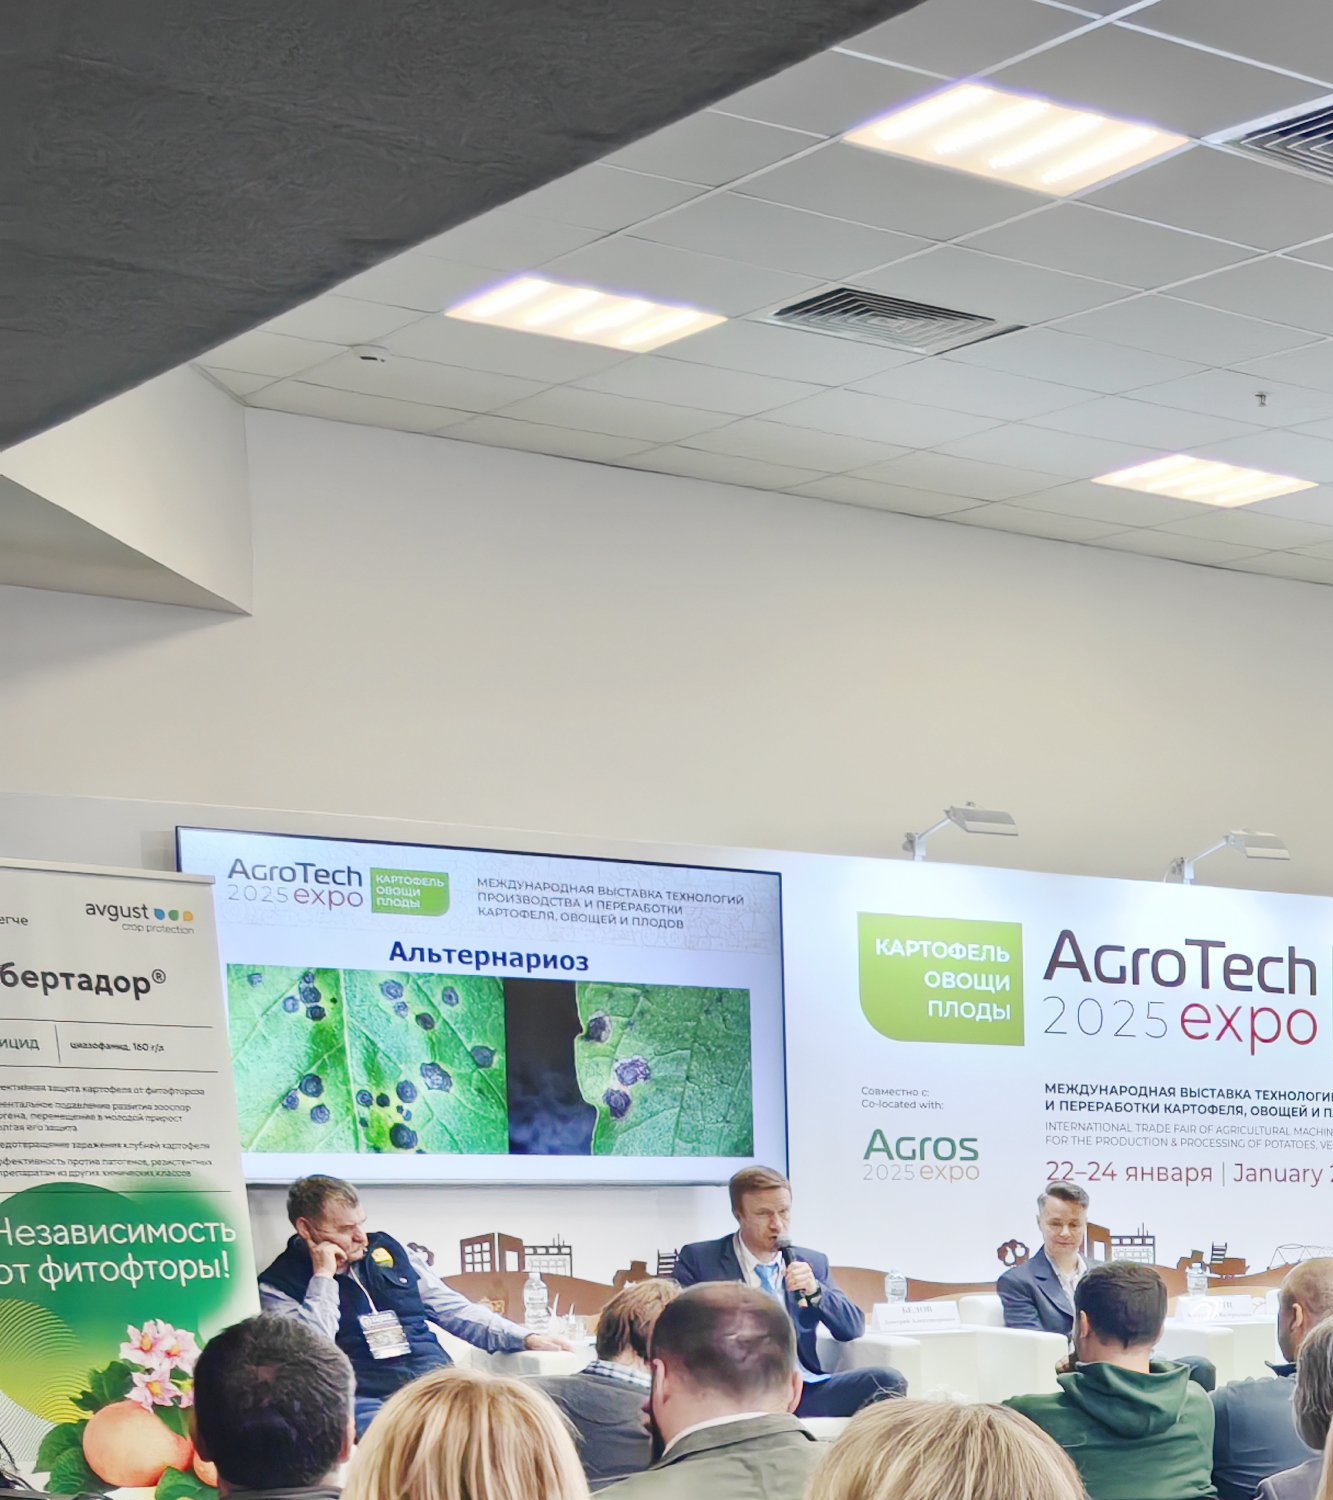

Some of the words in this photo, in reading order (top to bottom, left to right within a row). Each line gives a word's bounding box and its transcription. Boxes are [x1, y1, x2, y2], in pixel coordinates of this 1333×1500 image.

[227, 858, 362, 887] AgroTech
[375, 874, 445, 888] КАРТОФЕЛЬ
[227, 884, 289, 904] 2025
[293, 888, 364, 911] expo
[376, 886, 421, 899] ОВОЩИ
[477, 877, 594, 896] МЕЖДУНАРОДНАЯ
[597, 886, 662, 900] ВЫСТАВКА
[666, 890, 744, 905] ТЕХНОЛОГИЙ
[85, 903, 149, 922] avgust
[376, 898, 421, 909] ПЛОДЫ
[478, 892, 580, 908] ПРОИЗВОДСТВА
[584, 900, 593, 908] И
[596, 900, 682, 915] ПЕРЕРАБОТКИ
[122, 923, 144, 933] crop
[147, 925, 194, 935] protection
[478, 907, 558, 922] КАРТОФЕЛЯ,
[560, 912, 616, 926] ОВОЩЕЙ
[620, 916, 628, 926] И
[632, 917, 684, 930] ПЛОДОВ
[389, 941, 589, 973] Альтернариоз
[876, 938, 1010, 963] КАРТОФЕЛЬ
[1043, 929, 1317, 996] AgroTech
[924, 971, 1010, 993] ОВОЩИ
[928, 1000, 1011, 1022] ПЛОДЫ
[1043, 996, 1168, 1039] 2025
[1180, 1003, 1317, 1056] expo
[861, 1086, 919, 1097] Совместно
[1045, 1083, 1176, 1098] МЕЖДУНАРОДНАЯ
[1180, 1087, 1251, 1100] ВЫСТАВКА
[861, 1099, 916, 1109] Co-located
[919, 1100, 944, 1110] with:
[1045, 1100, 1055, 1111] И
[1059, 1101, 1160, 1114] ПЕРЕРАБОТКИ
[1164, 1103, 1247, 1118] КАРТОФЕЛЯ,
[1250, 1105, 1308, 1118] ОВОЩЕЙ
[1311, 1107, 1320, 1117] И
[1045, 1121, 1132, 1133] INTERNATIONAL
[1136, 1123, 1171, 1134] TRADE
[1174, 1124, 1197, 1134] FAIR
[1199, 1124, 1213, 1134] OF
[1215, 1125, 1291, 1136] AGRICULTURAL
[863, 1128, 979, 1161] Agros
[1045, 1136, 1068, 1146] FOR
[1071, 1136, 1092, 1146] THE
[1096, 1136, 1168, 1147] PRODUCTION
[1171, 1138, 1177, 1147] &
[1180, 1138, 1245, 1148] PROCESSING
[1248, 1138, 1262, 1148] OF
[1265, 1139, 1317, 1150] POTATOES,
[863, 1164, 915, 1181] 2025
[920, 1165, 980, 1184] expo
[1125, 1166, 1213, 1187] января
[1233, 1163, 1324, 1188] January
[38, 1250, 231, 1291] фитофторы!
